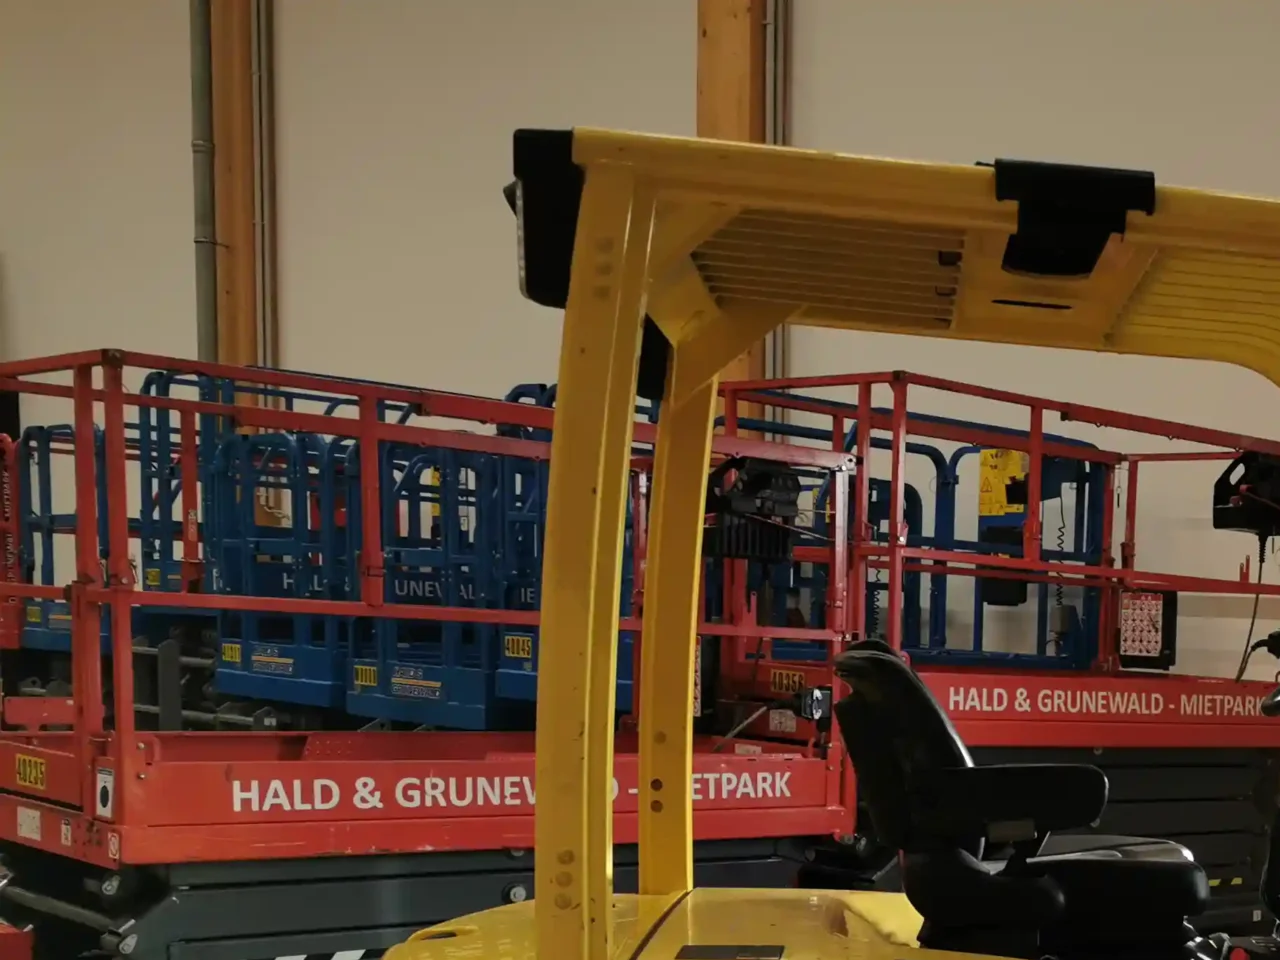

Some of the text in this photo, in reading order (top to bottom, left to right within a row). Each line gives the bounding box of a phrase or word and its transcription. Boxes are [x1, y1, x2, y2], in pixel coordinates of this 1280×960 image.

[948, 686, 1008, 712] HALD
[1014, 687, 1032, 712] &
[1037, 688, 1164, 715] GRUNEWALD
[1180, 693, 1267, 717] MIETPARK
[232, 778, 340, 812] HALD
[353, 776, 384, 809] &
[692, 771, 791, 800] ETPARK
